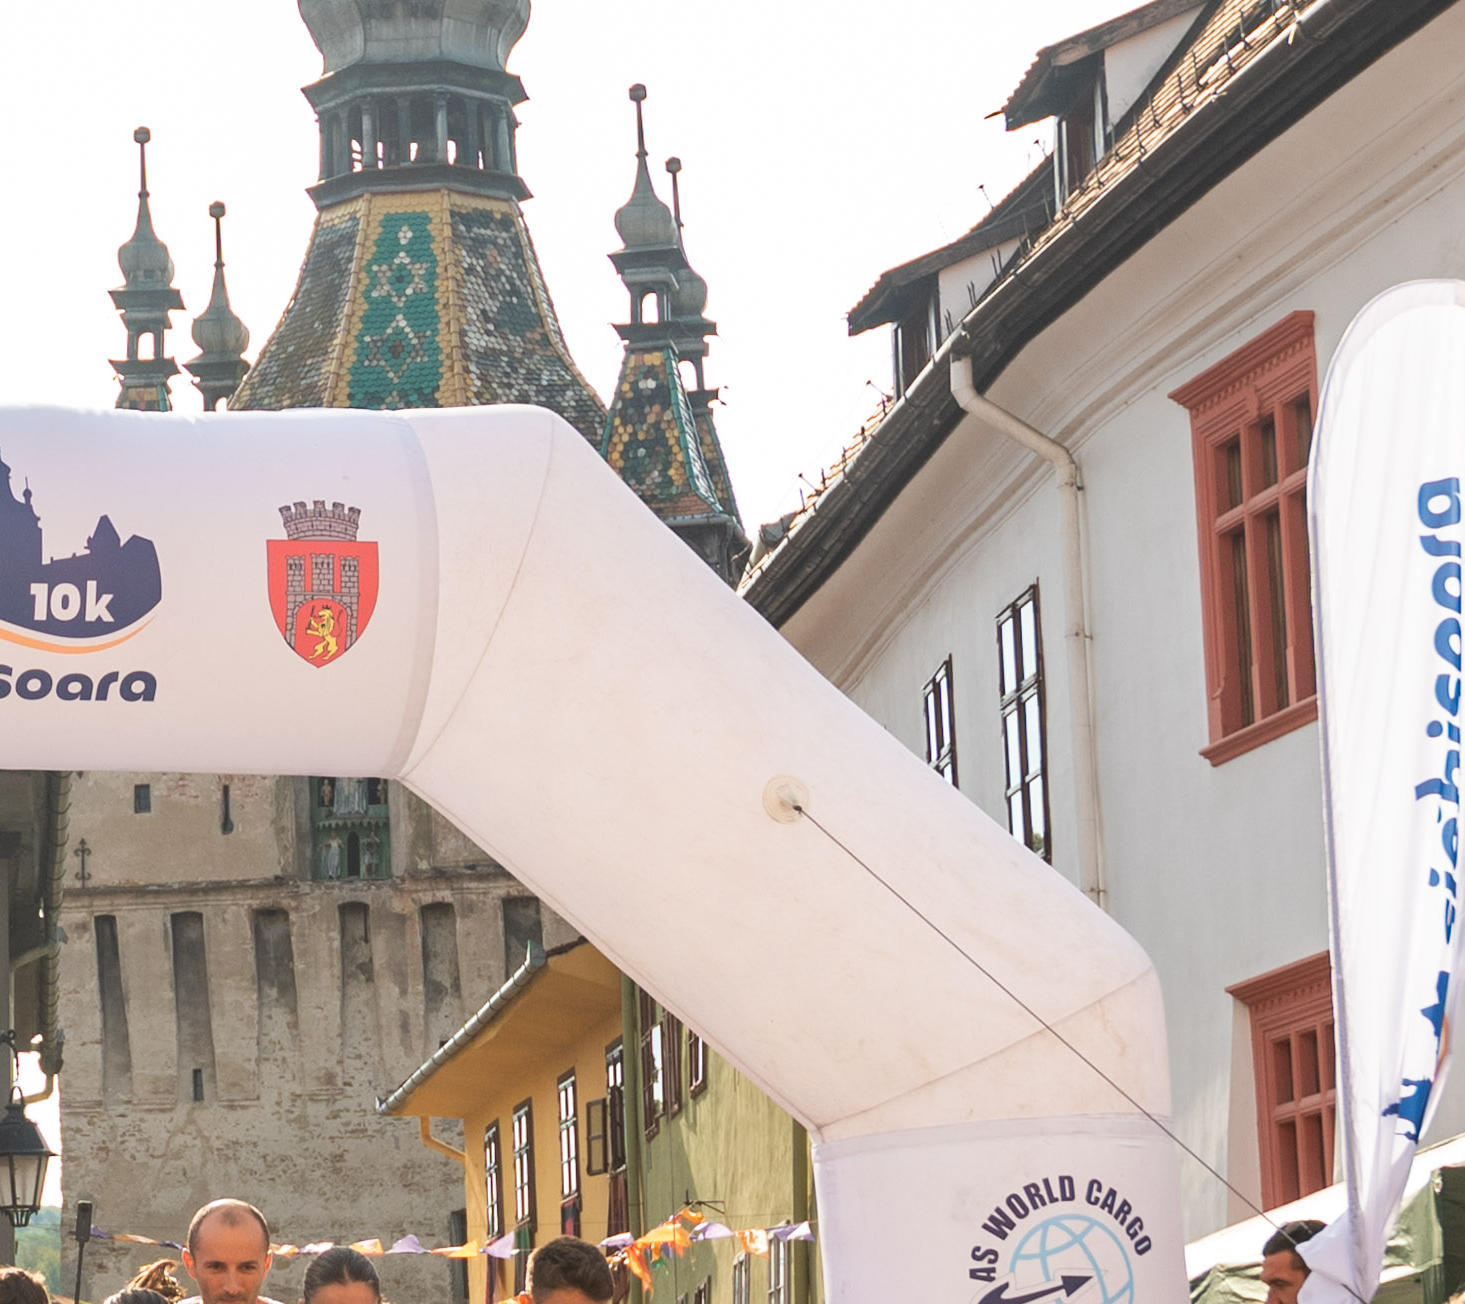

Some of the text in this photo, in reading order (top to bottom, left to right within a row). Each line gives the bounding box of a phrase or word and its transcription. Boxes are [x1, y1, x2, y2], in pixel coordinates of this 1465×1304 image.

[30, 582, 114, 624] 10k
[969, 1175, 1152, 1282] AS WORLD CARGO
